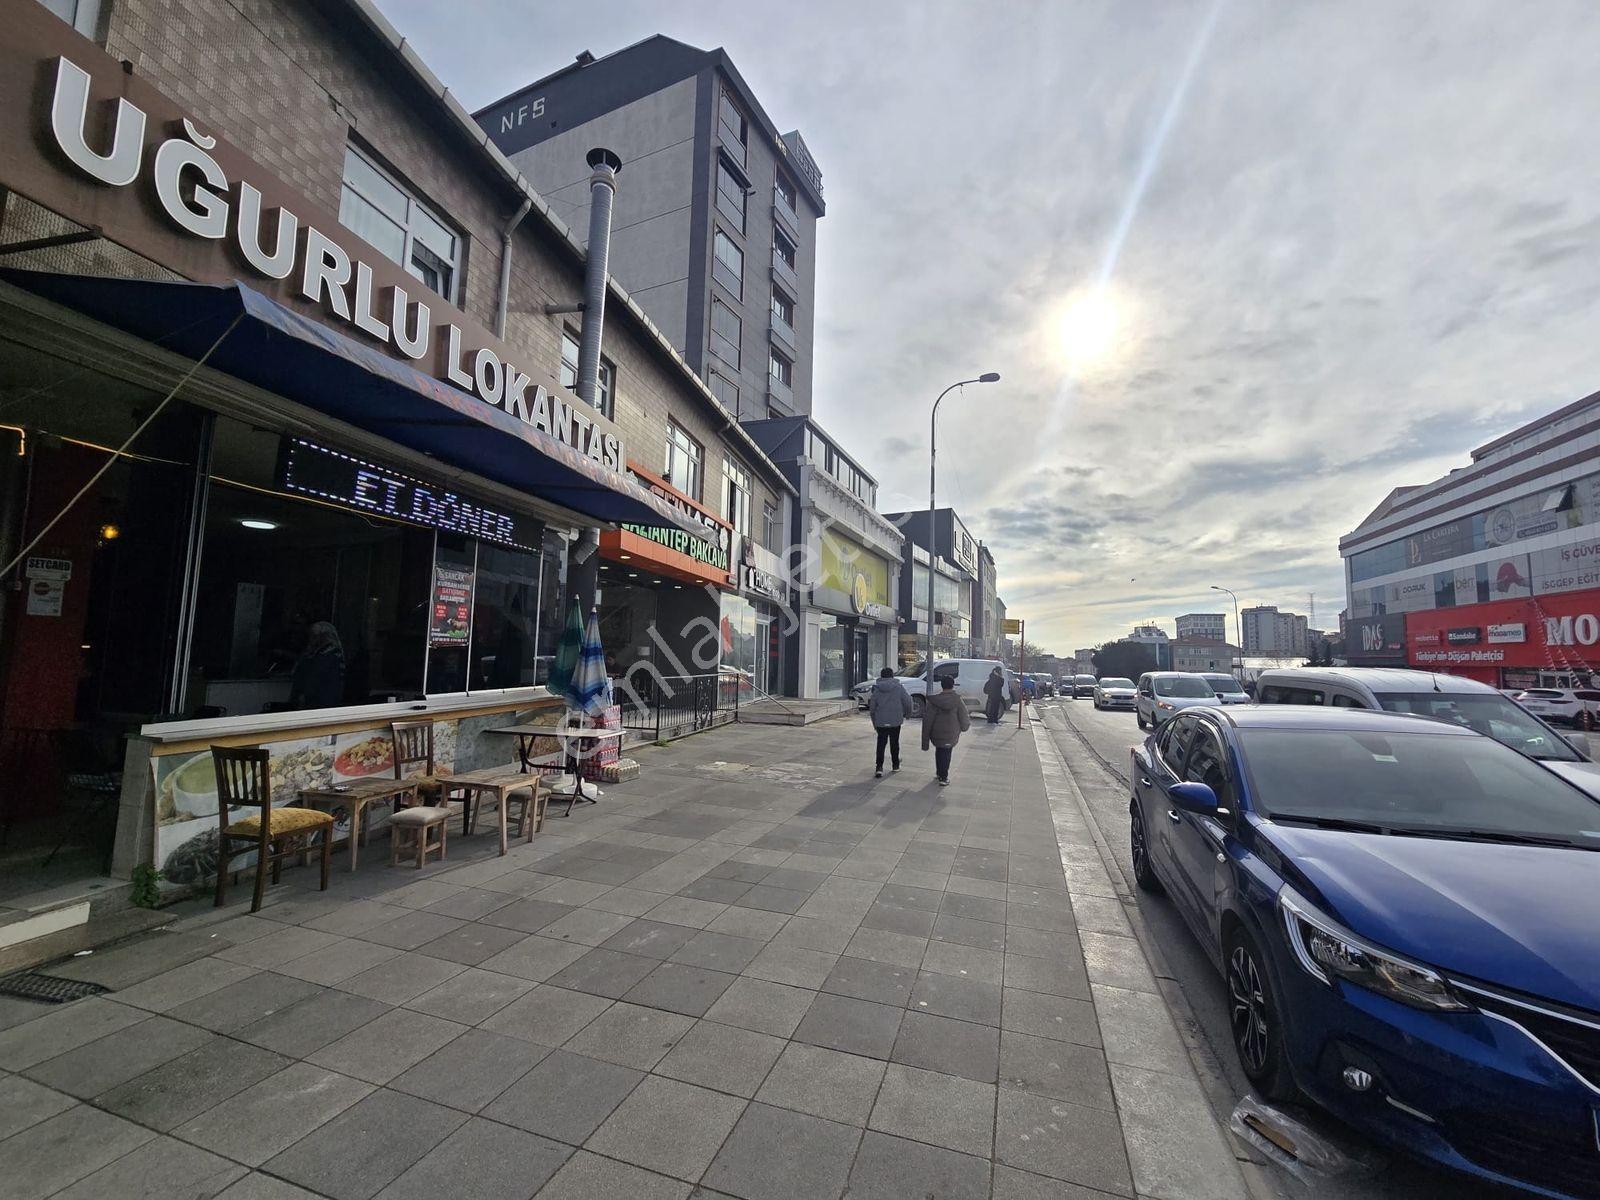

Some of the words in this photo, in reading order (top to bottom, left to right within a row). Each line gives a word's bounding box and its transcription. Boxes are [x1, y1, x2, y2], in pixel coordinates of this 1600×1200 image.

[501, 97, 546, 134] NFS
[50, 56, 430, 360] UĞURLU
[447, 324, 626, 473] LOKANTASI
[355, 471, 406, 511] ET
[412, 487, 515, 543] DÖNER
[690, 536, 728, 570] BAKLAVA
[1546, 613, 1600, 647] MO
